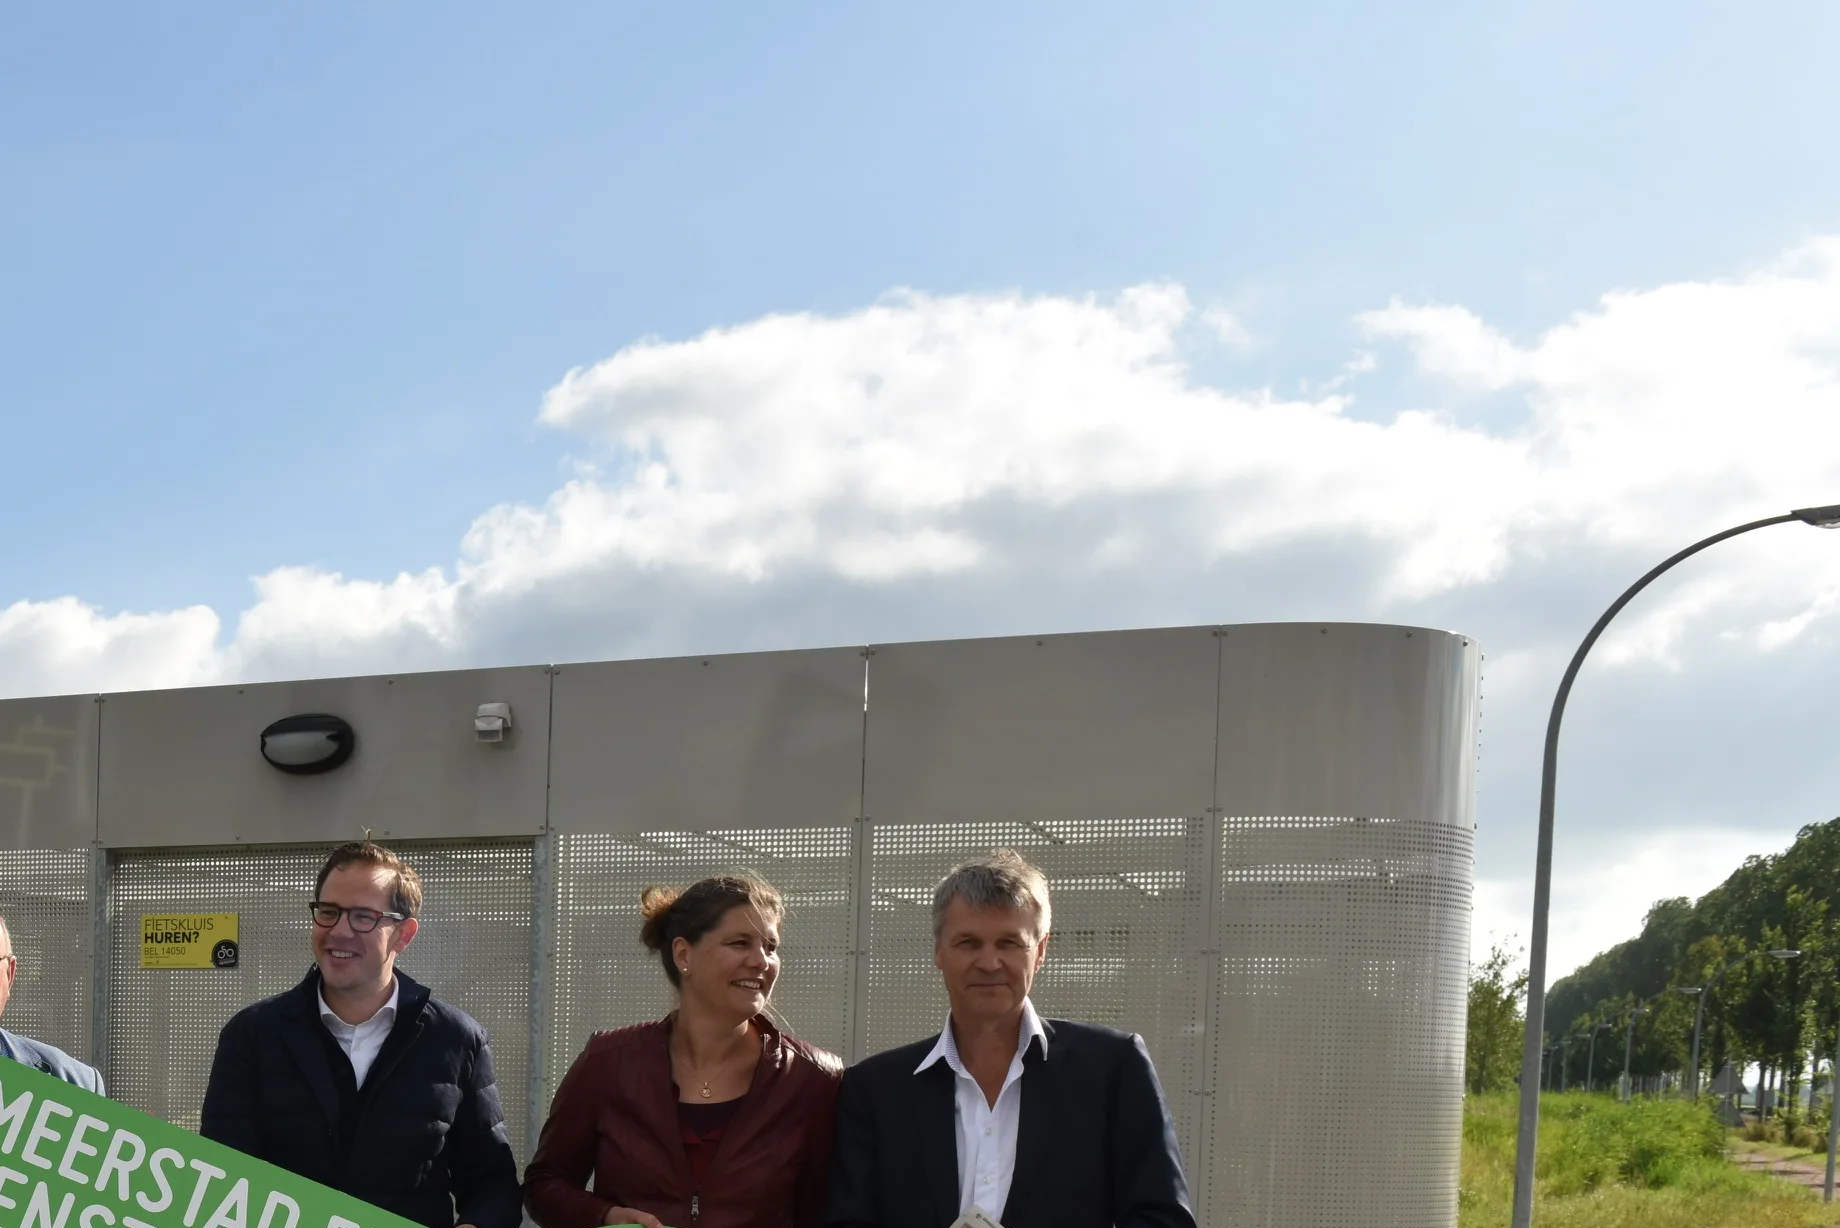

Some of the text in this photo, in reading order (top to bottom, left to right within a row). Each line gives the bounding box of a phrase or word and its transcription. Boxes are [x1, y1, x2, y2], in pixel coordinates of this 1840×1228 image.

[144, 917, 214, 931] FIETSKLUIS
[144, 931, 200, 944] HUREN?
[144, 946, 186, 956] BEL 14050
